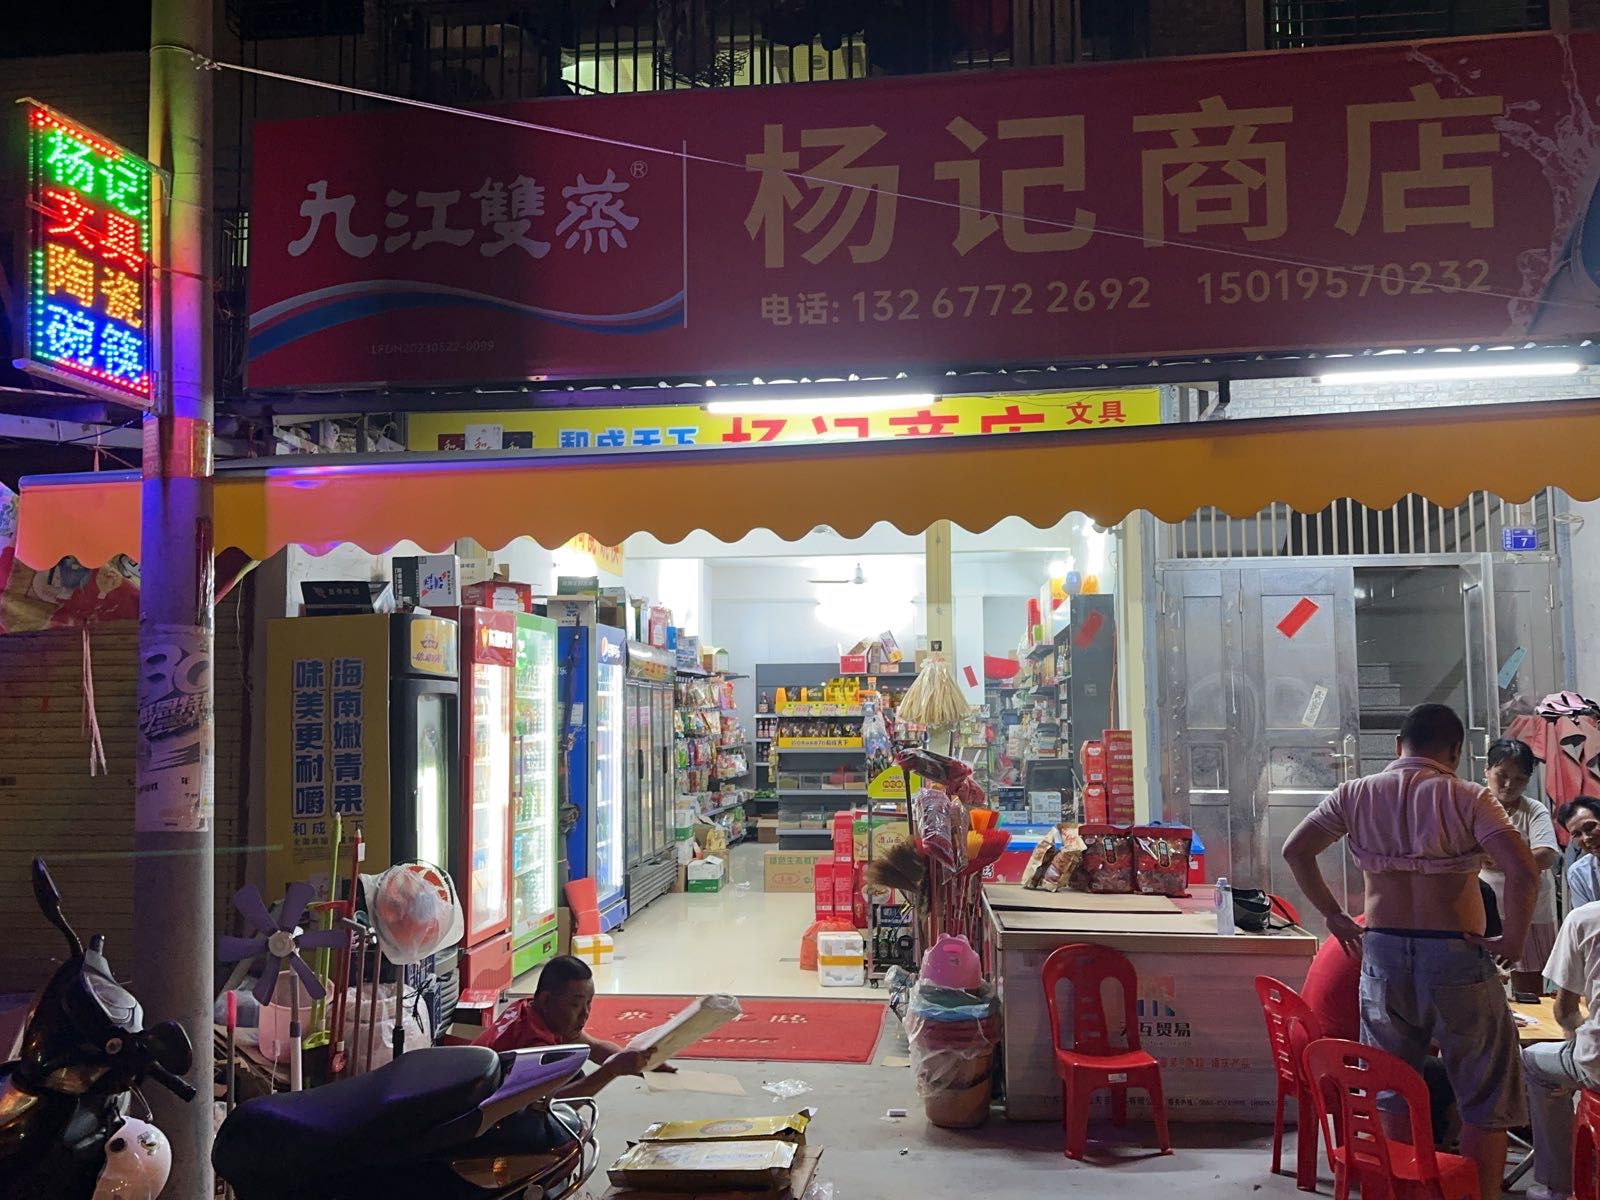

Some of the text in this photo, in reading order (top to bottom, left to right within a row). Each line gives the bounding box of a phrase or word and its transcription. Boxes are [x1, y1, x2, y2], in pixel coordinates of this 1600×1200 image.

[286, 168, 640, 259] 九江雙蒸
[744, 82, 1504, 269] 杨记商店
[47, 191, 144, 273] 文具
[47, 243, 143, 329] 陶瓷
[1197, 258, 1492, 306] 15019570232
[46, 303, 143, 383] 碗筷
[1065, 400, 1127, 425] 文具
[1520, 537, 1529, 547] 7
[294, 659, 326, 816] 味美更耐嚼
[332, 658, 363, 814] 海南嫩青果
[293, 819, 364, 835] 和成下
